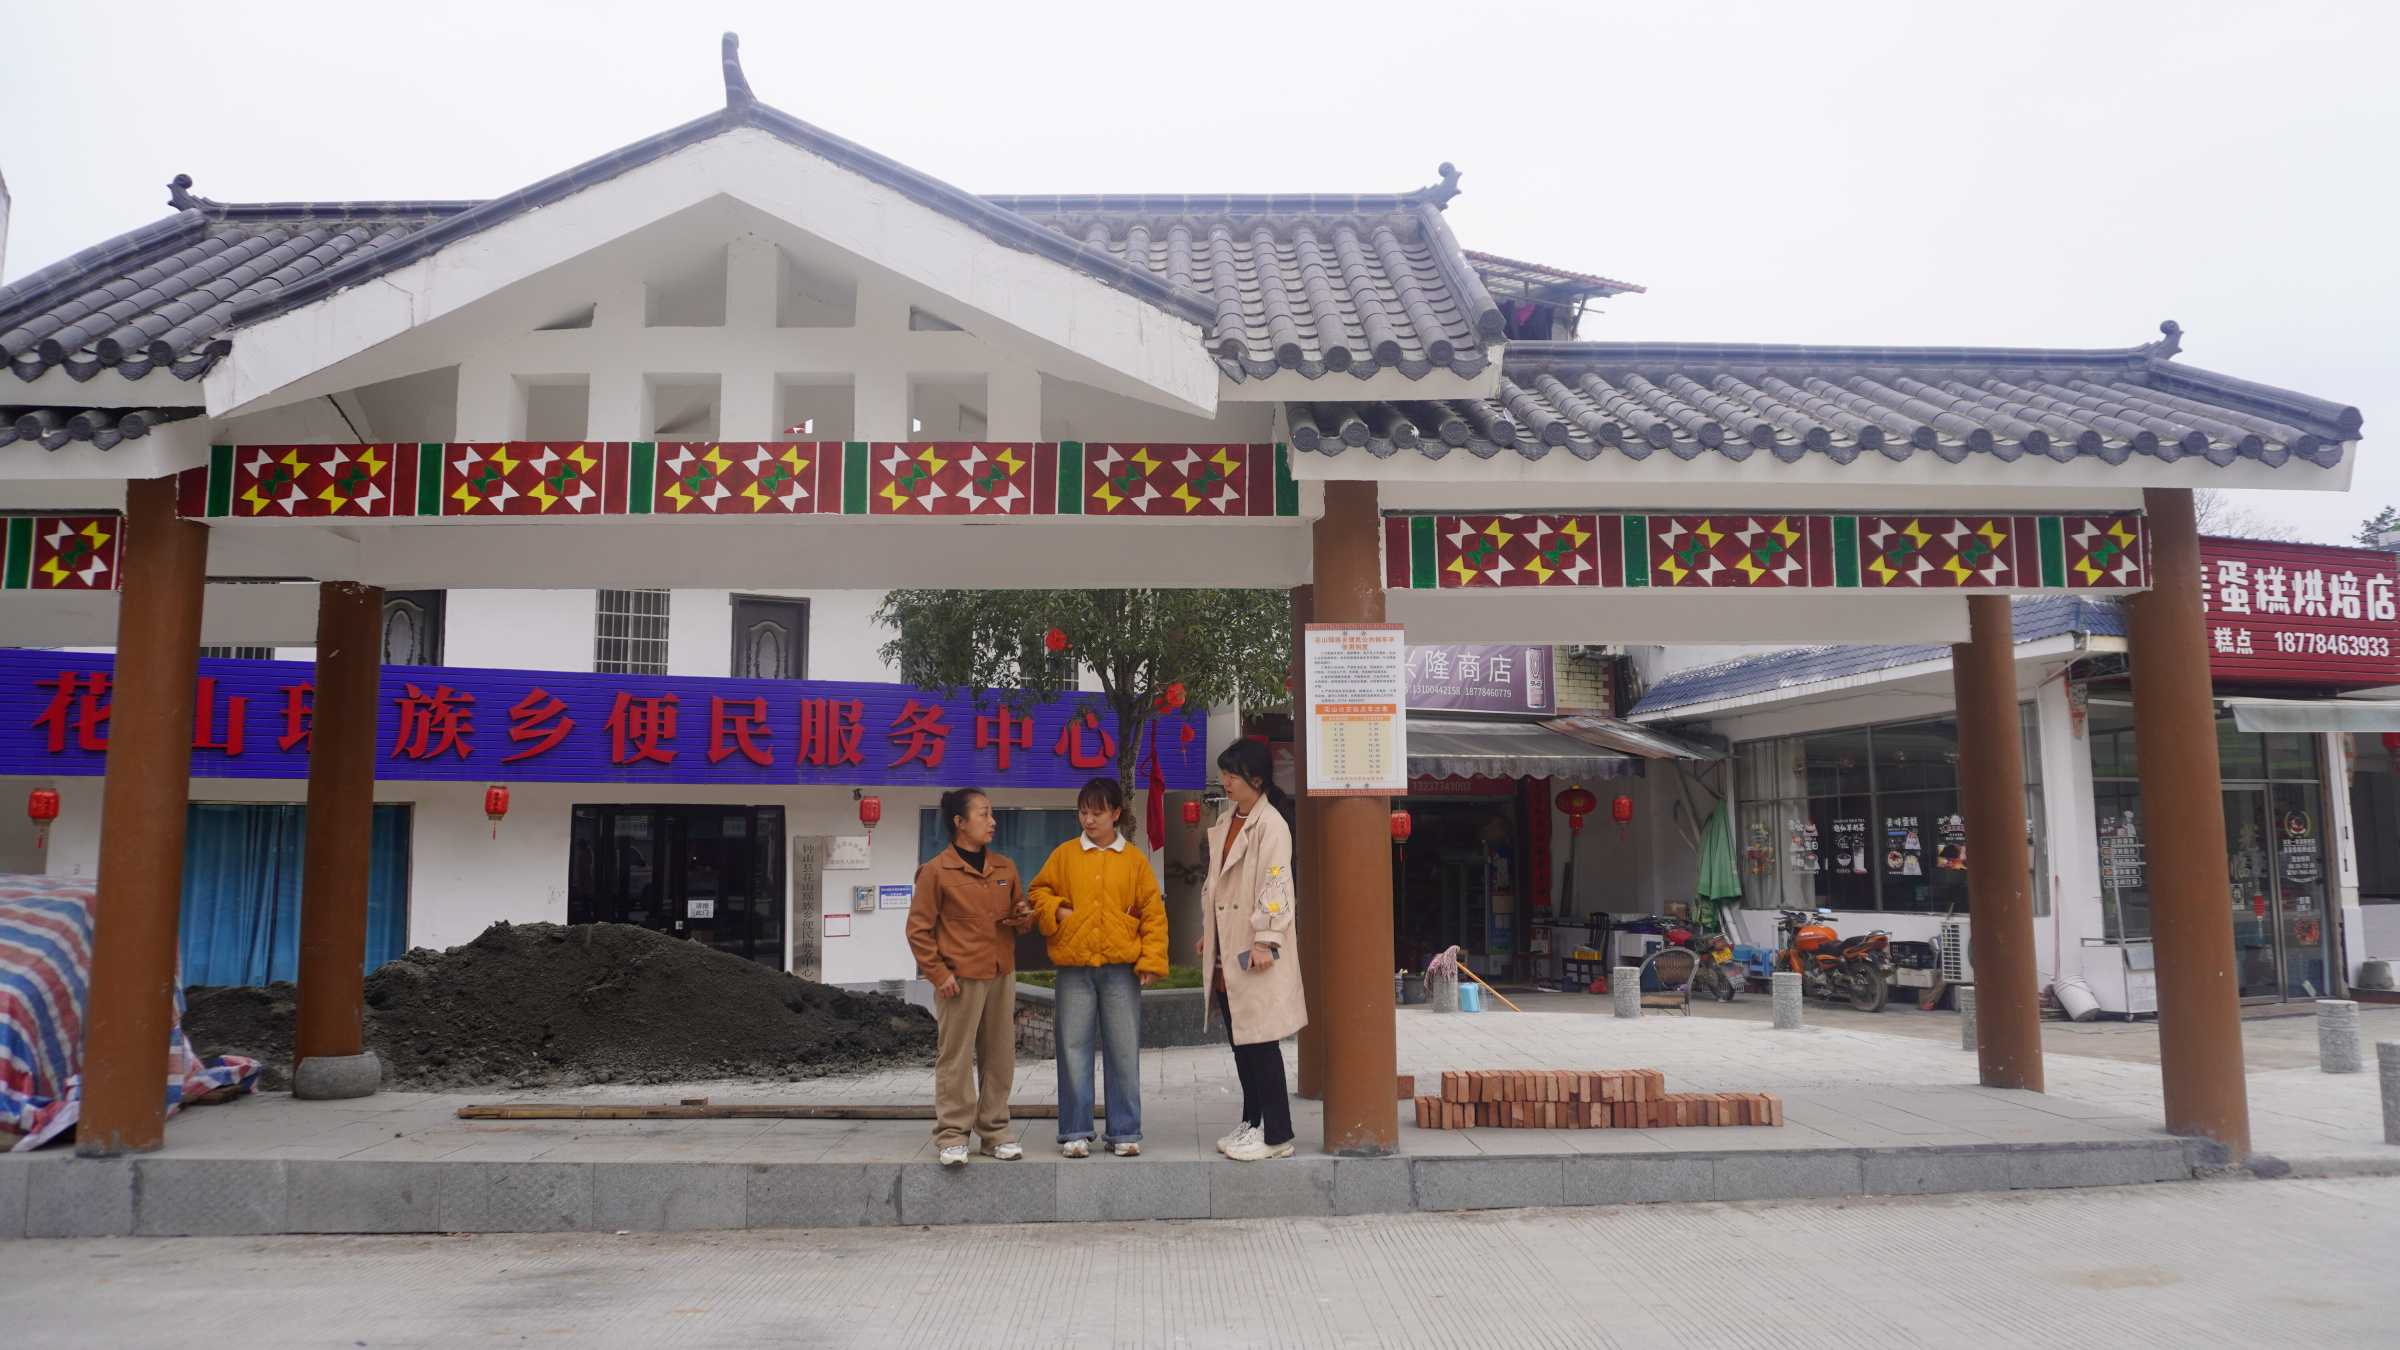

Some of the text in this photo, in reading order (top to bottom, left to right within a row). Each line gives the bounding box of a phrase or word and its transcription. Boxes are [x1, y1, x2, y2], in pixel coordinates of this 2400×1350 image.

[2213, 626, 2390, 657] 糕点 18778463933
[1465, 687, 1512, 698] 18778460779
[1412, 781, 1471, 791] 13237741003
[1805, 841, 1819, 851] 生日
[802, 844, 814, 978] 钟山县花山瑶族乡便民服务中心
